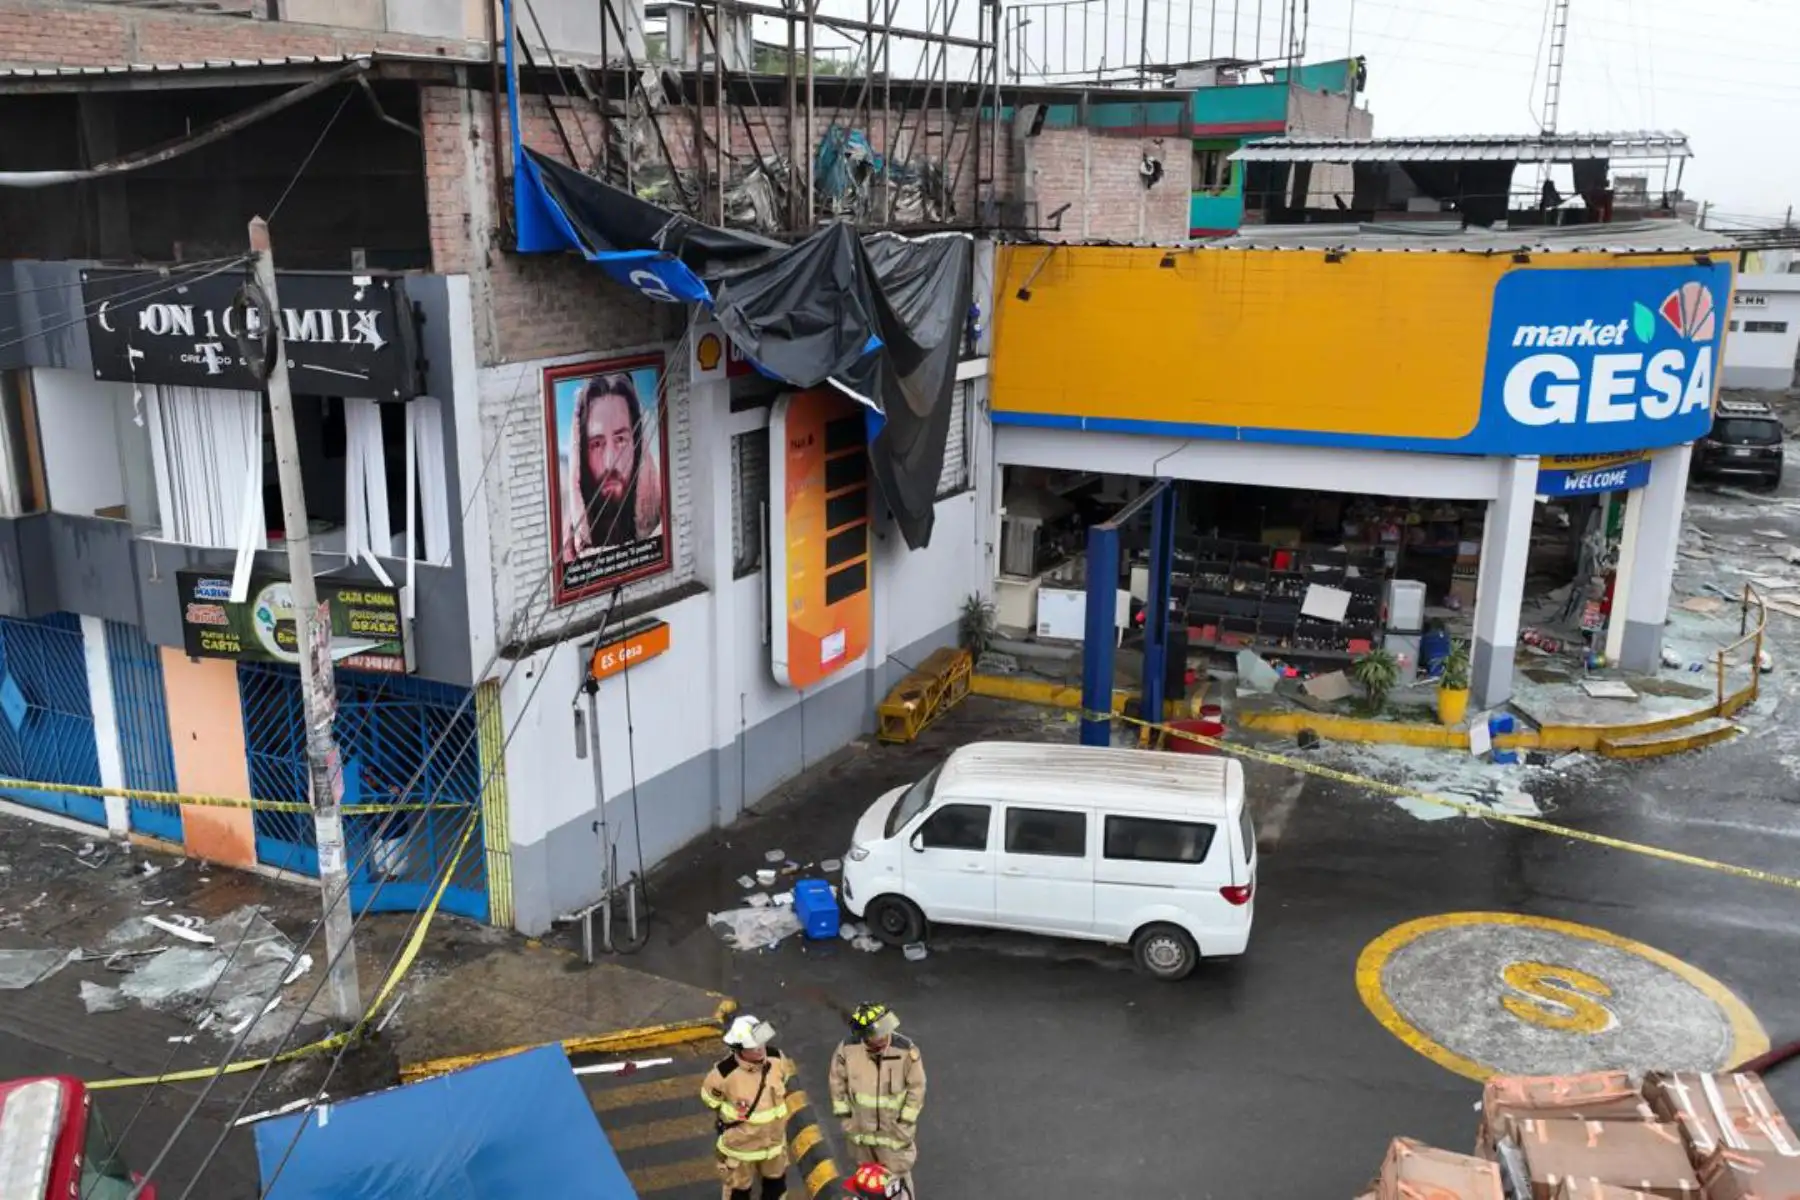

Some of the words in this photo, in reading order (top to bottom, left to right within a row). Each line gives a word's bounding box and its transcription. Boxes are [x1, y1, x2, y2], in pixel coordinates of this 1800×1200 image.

[1513, 319, 1629, 347] market
[1503, 346, 1711, 426] GESA
[1564, 469, 1628, 490] WELCOME
[350, 620, 397, 634] BRASA
[201, 639, 241, 653] CARTA
[1503, 960, 1616, 1033] S
